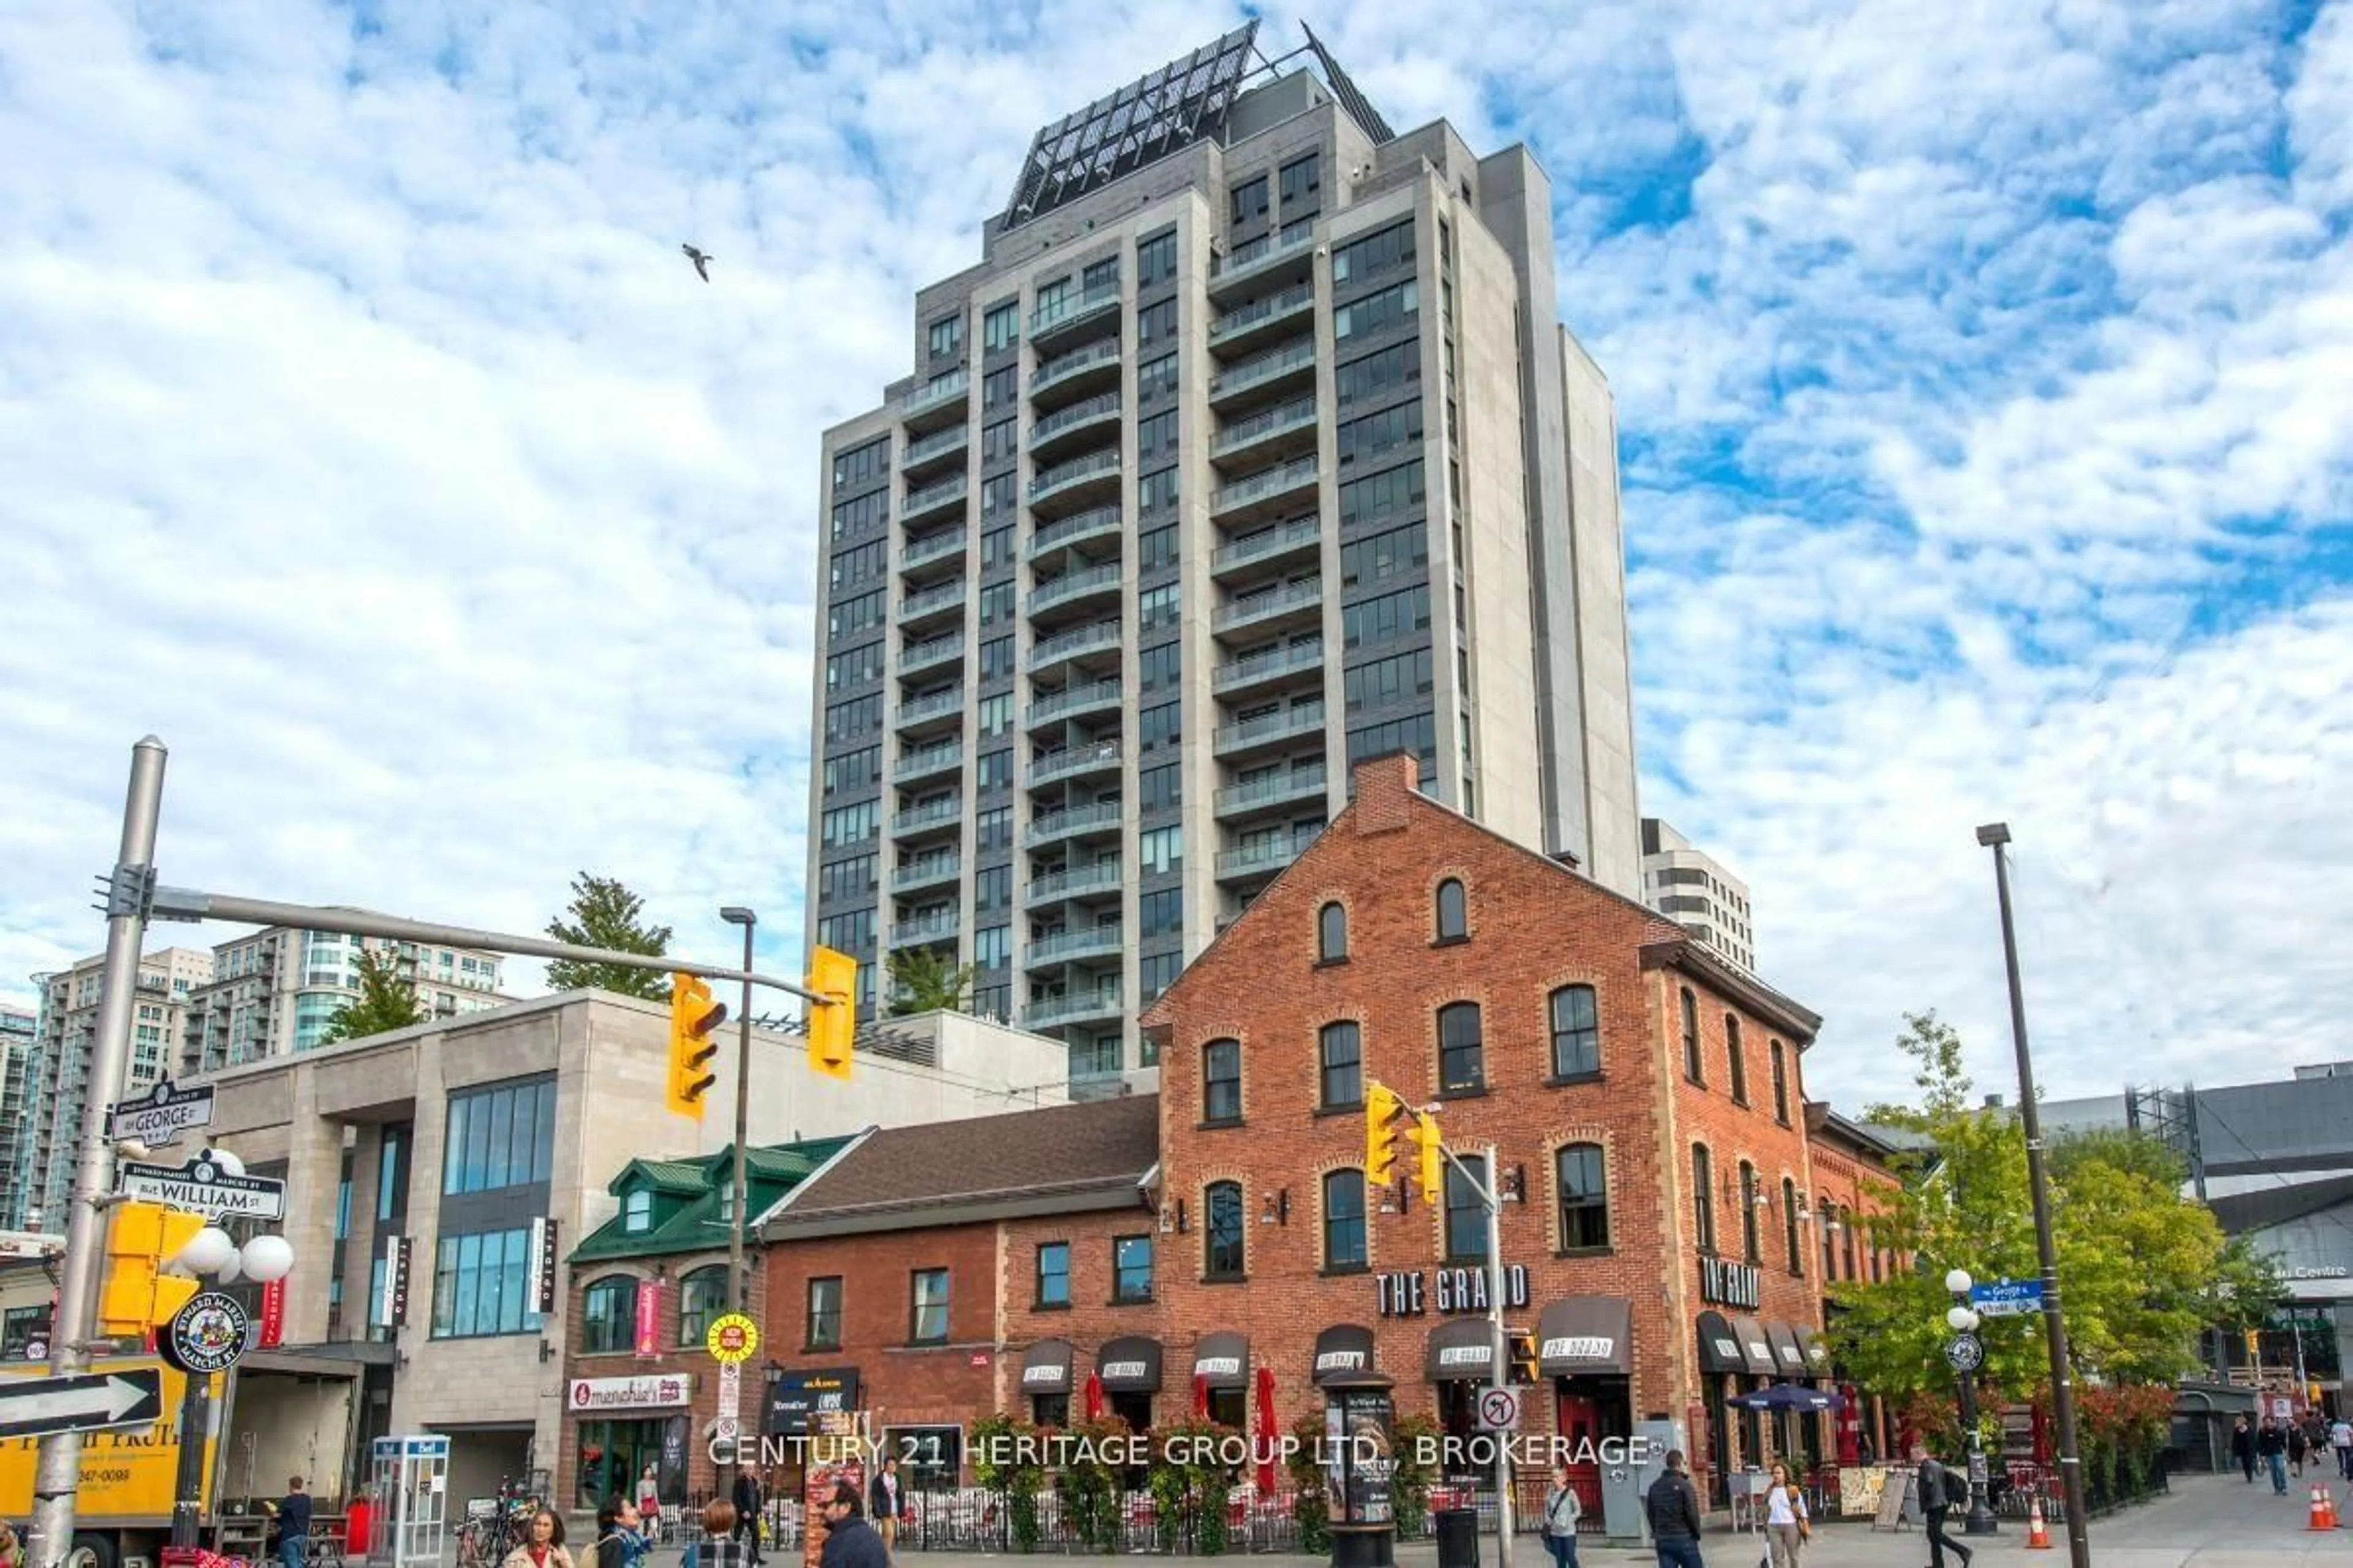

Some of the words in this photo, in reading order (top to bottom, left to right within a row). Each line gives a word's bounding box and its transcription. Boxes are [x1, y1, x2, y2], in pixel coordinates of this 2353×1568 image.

[135, 1106, 188, 1131] GEORGE
[161, 1183, 247, 1208] WILLIAM
[249, 1198, 260, 1206] ST
[2295, 1265, 2346, 1278] Centre
[1376, 1272, 1421, 1314] THE
[177, 1298, 211, 1331] BYWARD
[214, 1298, 245, 1333] MARKET
[223, 1348, 236, 1362] BY
